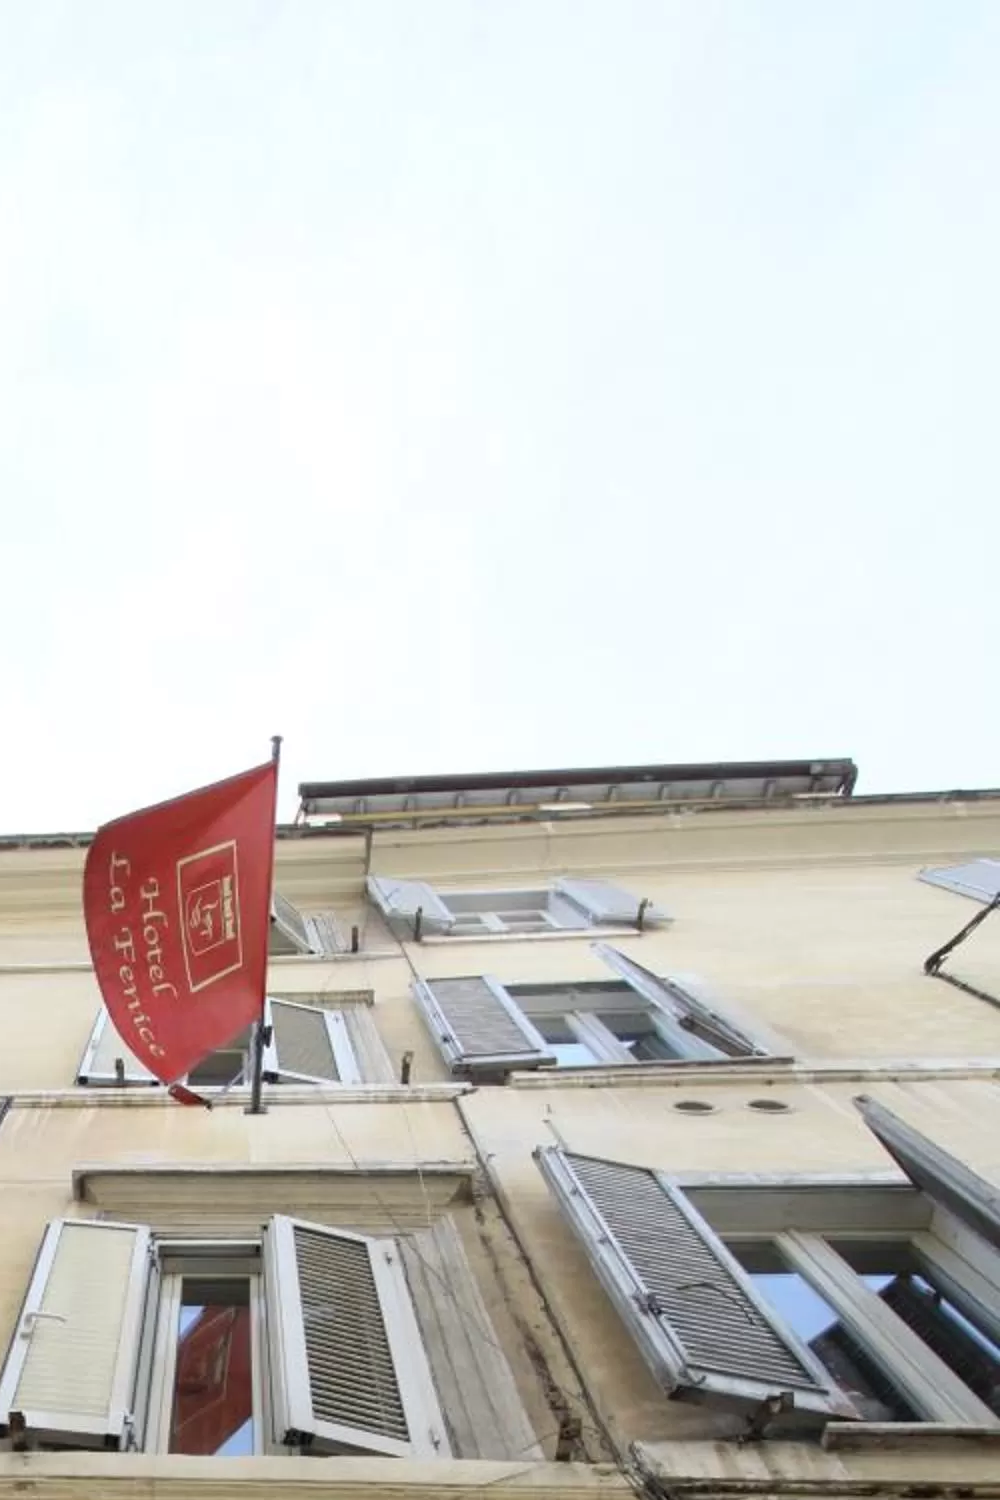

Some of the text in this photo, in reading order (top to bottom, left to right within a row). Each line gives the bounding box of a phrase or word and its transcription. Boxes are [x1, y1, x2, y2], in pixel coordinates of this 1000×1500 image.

[110, 851, 166, 1058] La Fenice
[140, 876, 178, 999] Hotel
